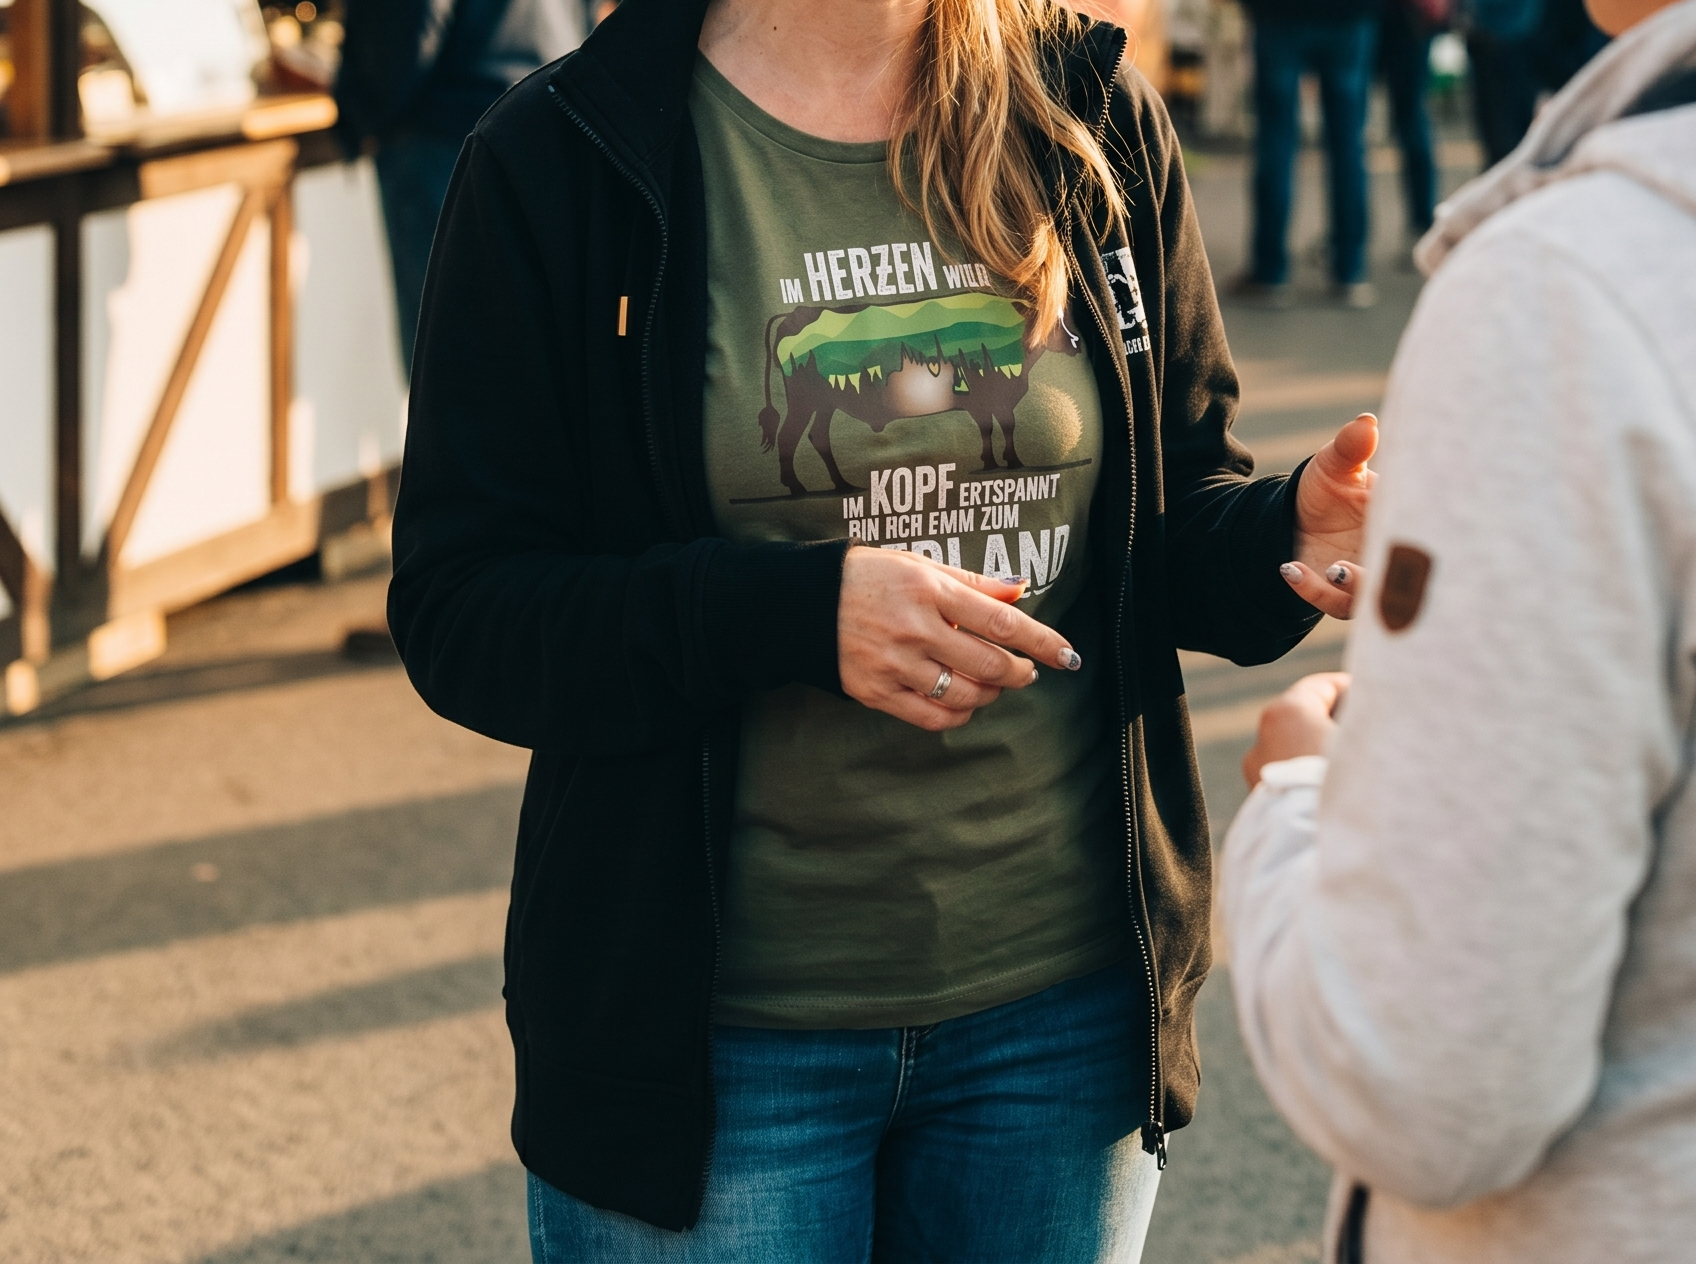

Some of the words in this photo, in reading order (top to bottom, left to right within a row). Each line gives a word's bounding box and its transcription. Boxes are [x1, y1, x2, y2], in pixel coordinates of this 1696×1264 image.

[779, 278, 804, 304] IM
[803, 241, 938, 302] HERZEN
[843, 496, 864, 519] IM
[870, 463, 956, 516] KOPF
[959, 473, 1061, 507] ERTSPANNT
[849, 518, 880, 542] BIN
[928, 508, 975, 535] EMM
[980, 503, 1020, 531] ZUM
